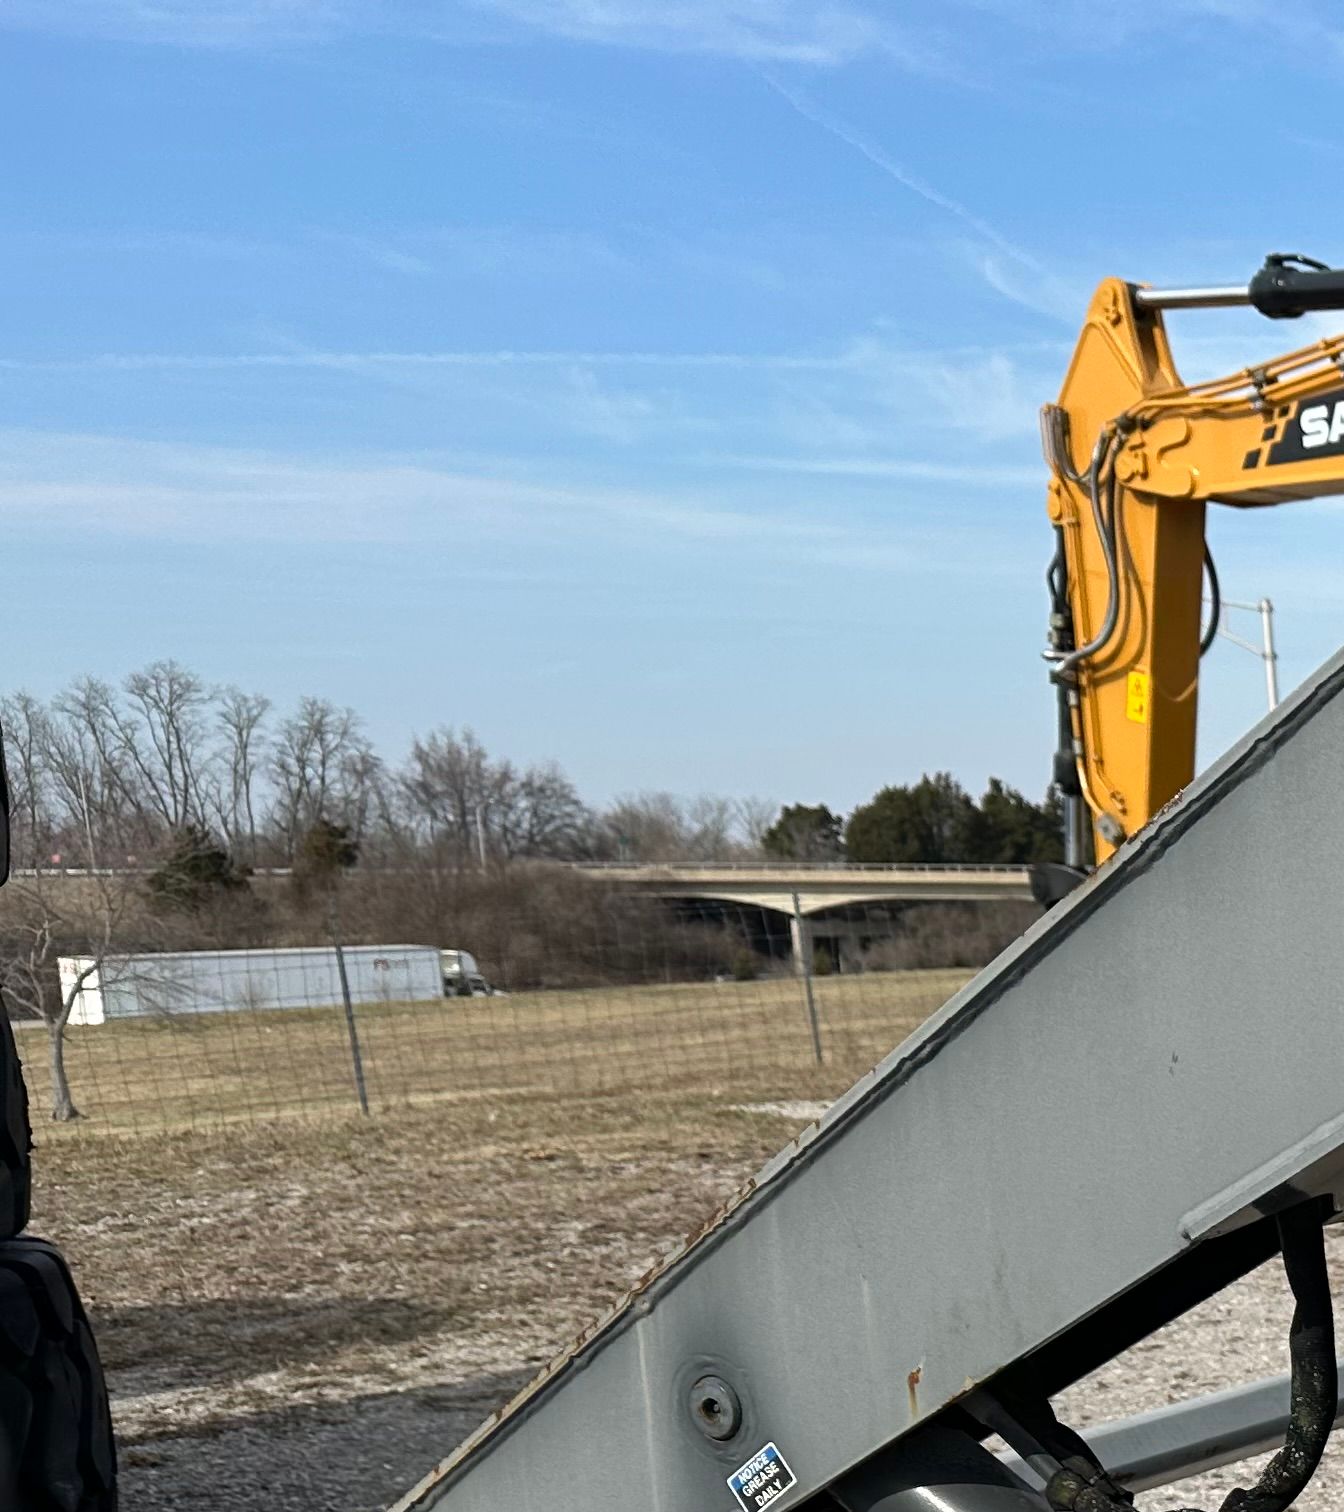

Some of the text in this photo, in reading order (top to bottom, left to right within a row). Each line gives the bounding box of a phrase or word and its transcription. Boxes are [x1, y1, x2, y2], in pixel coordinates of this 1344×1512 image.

[737, 1453, 769, 1484] NOTICE
[742, 1461, 779, 1496] GREASE
[754, 1479, 782, 1506] DAILY
